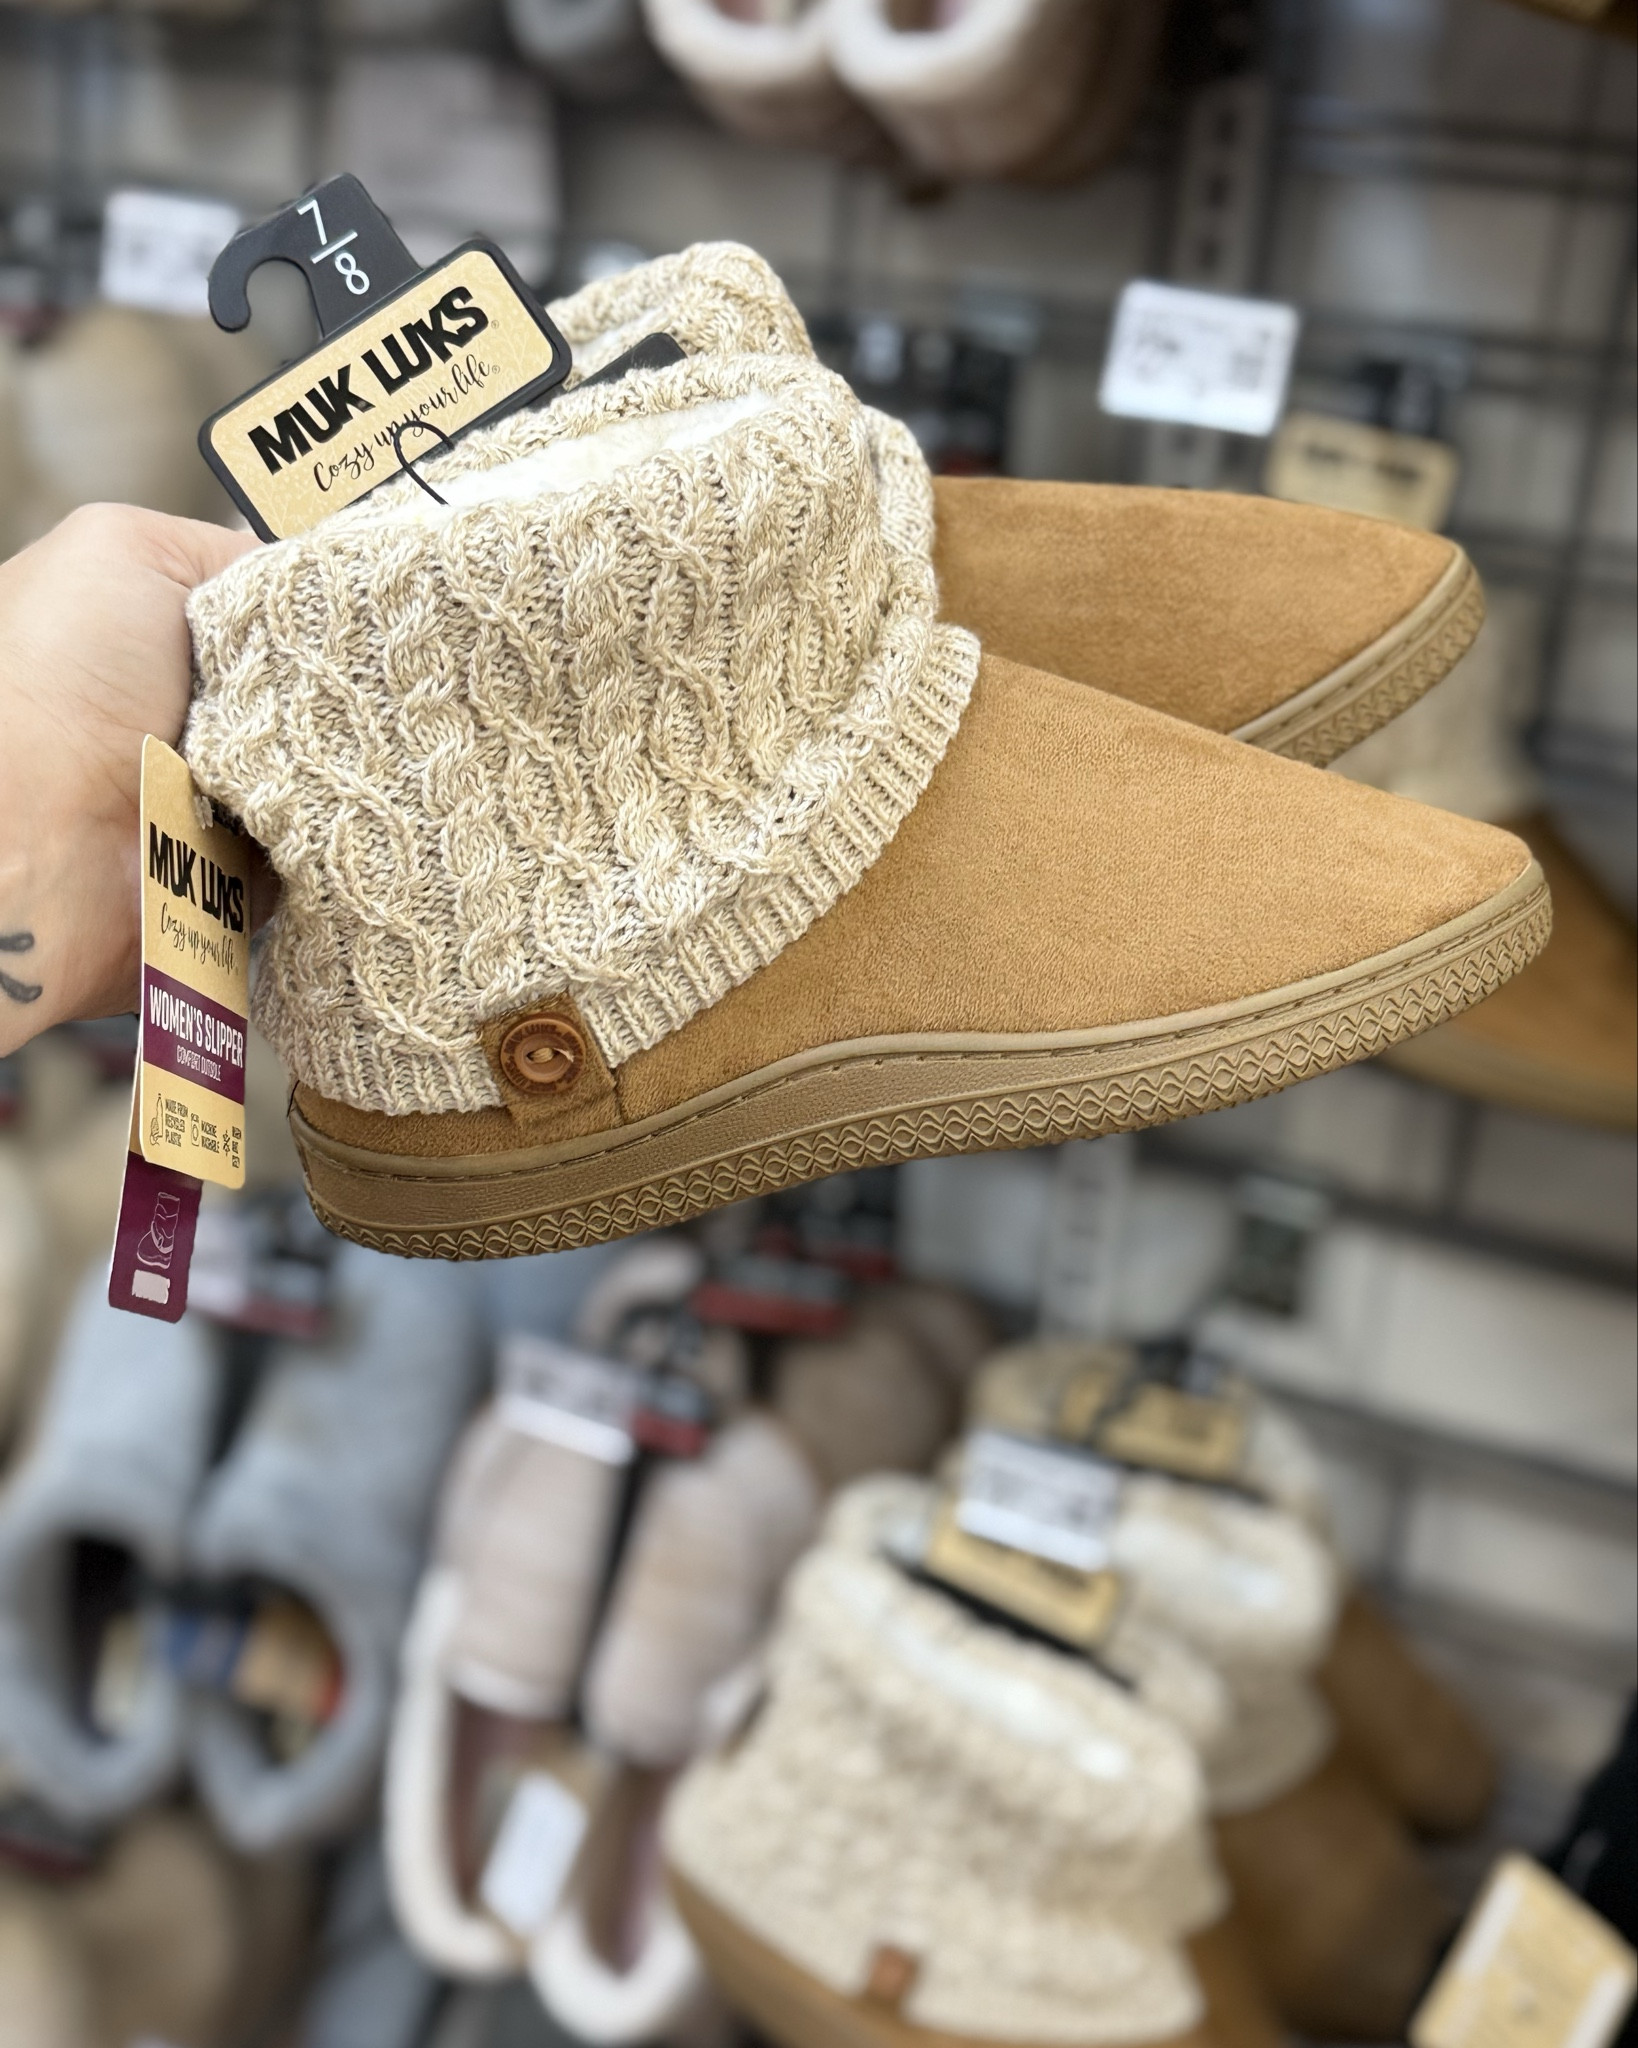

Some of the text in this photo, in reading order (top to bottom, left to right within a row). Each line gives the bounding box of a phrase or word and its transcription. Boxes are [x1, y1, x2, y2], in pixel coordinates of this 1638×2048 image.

[297, 198, 328, 246] 7
[334, 252, 371, 295] 8
[247, 285, 490, 476] MUK LUKS
[313, 442, 375, 493] Cozy
[402, 387, 458, 438] your
[451, 353, 491, 396] life
[149, 821, 244, 934] MUK LUKS
[161, 902, 187, 952] Cozy
[188, 926, 200, 959] up
[149, 984, 244, 1069] WOMEN'S SLIPPER
